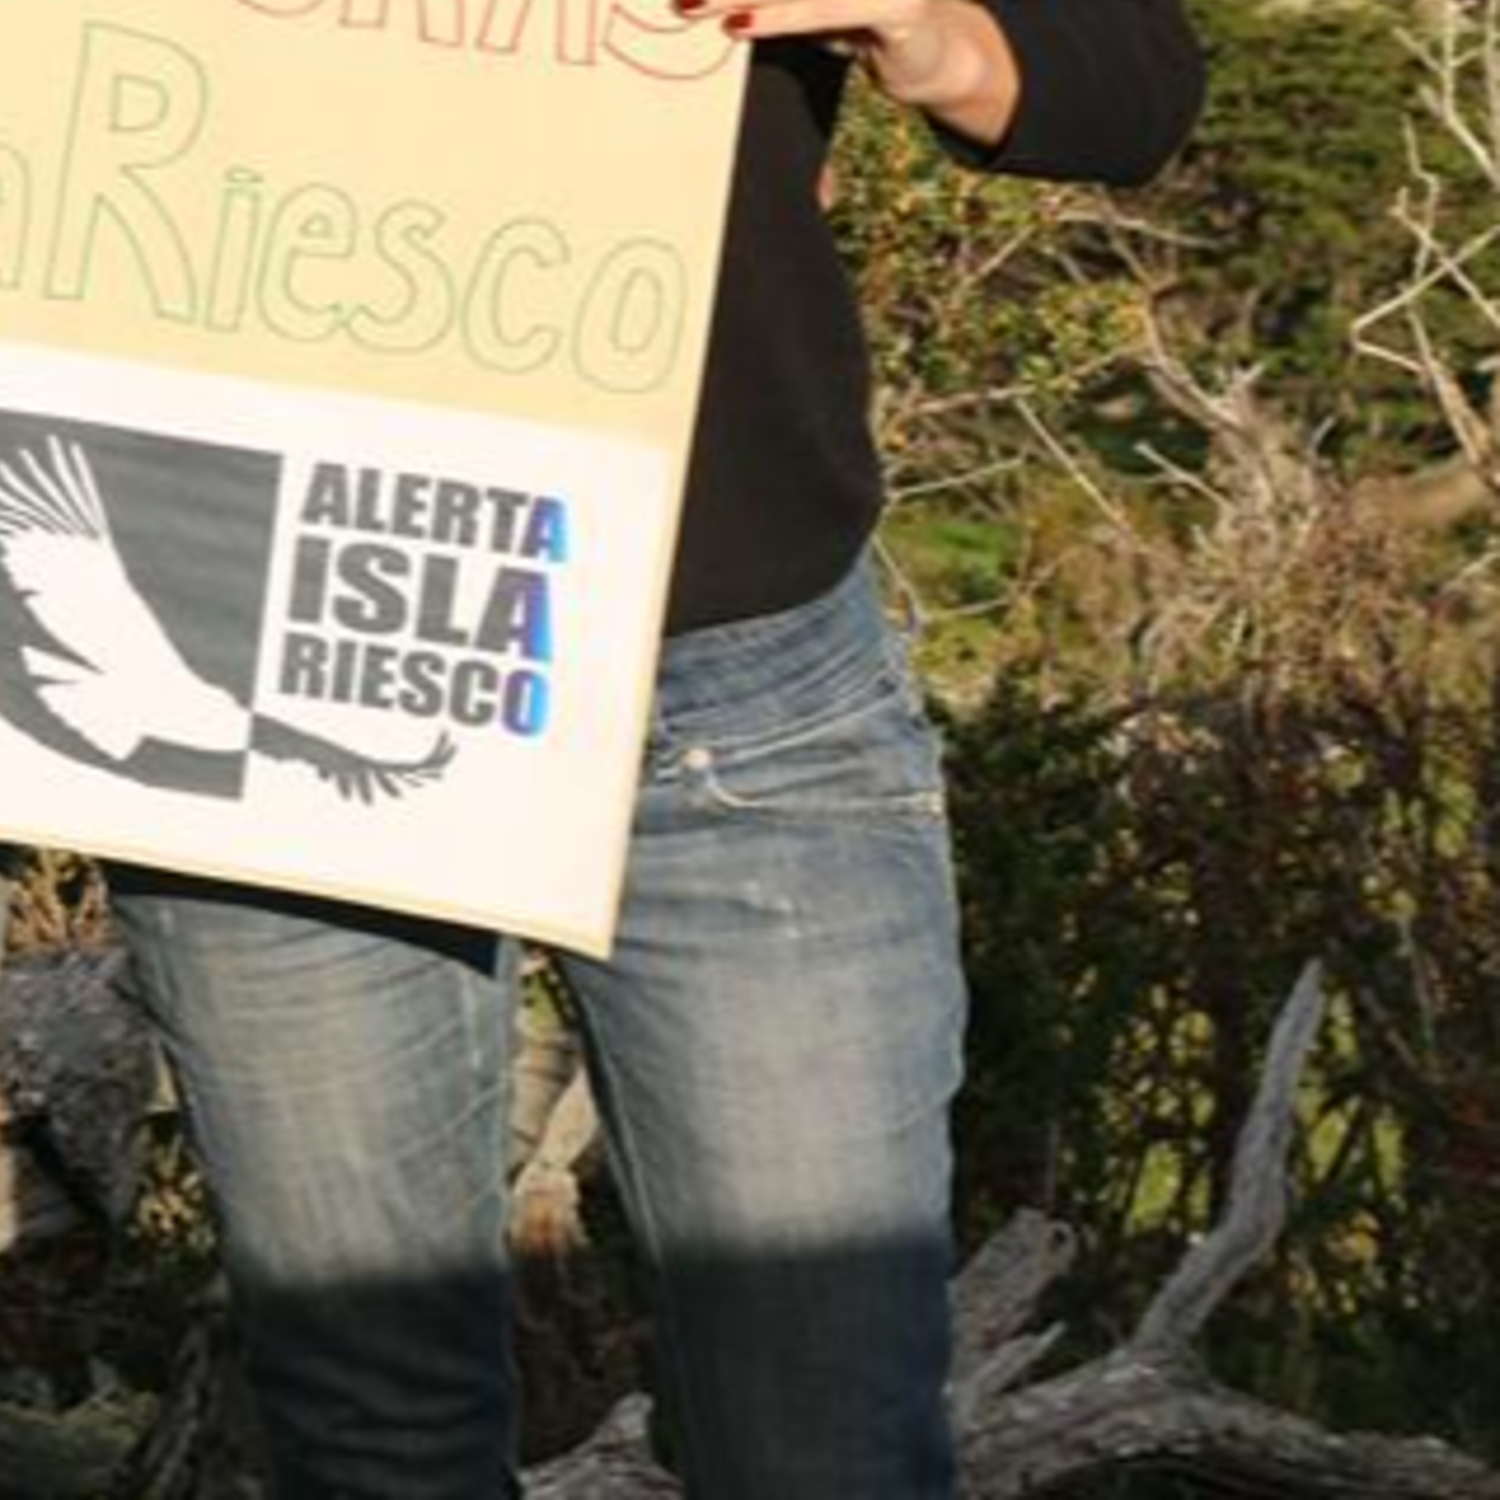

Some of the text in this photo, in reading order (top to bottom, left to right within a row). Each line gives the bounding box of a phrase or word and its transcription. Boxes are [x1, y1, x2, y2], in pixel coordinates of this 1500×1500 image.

[300, 460, 568, 563] ALERTA
[288, 534, 553, 663] ISLA
[278, 631, 550, 738] RIESCO
